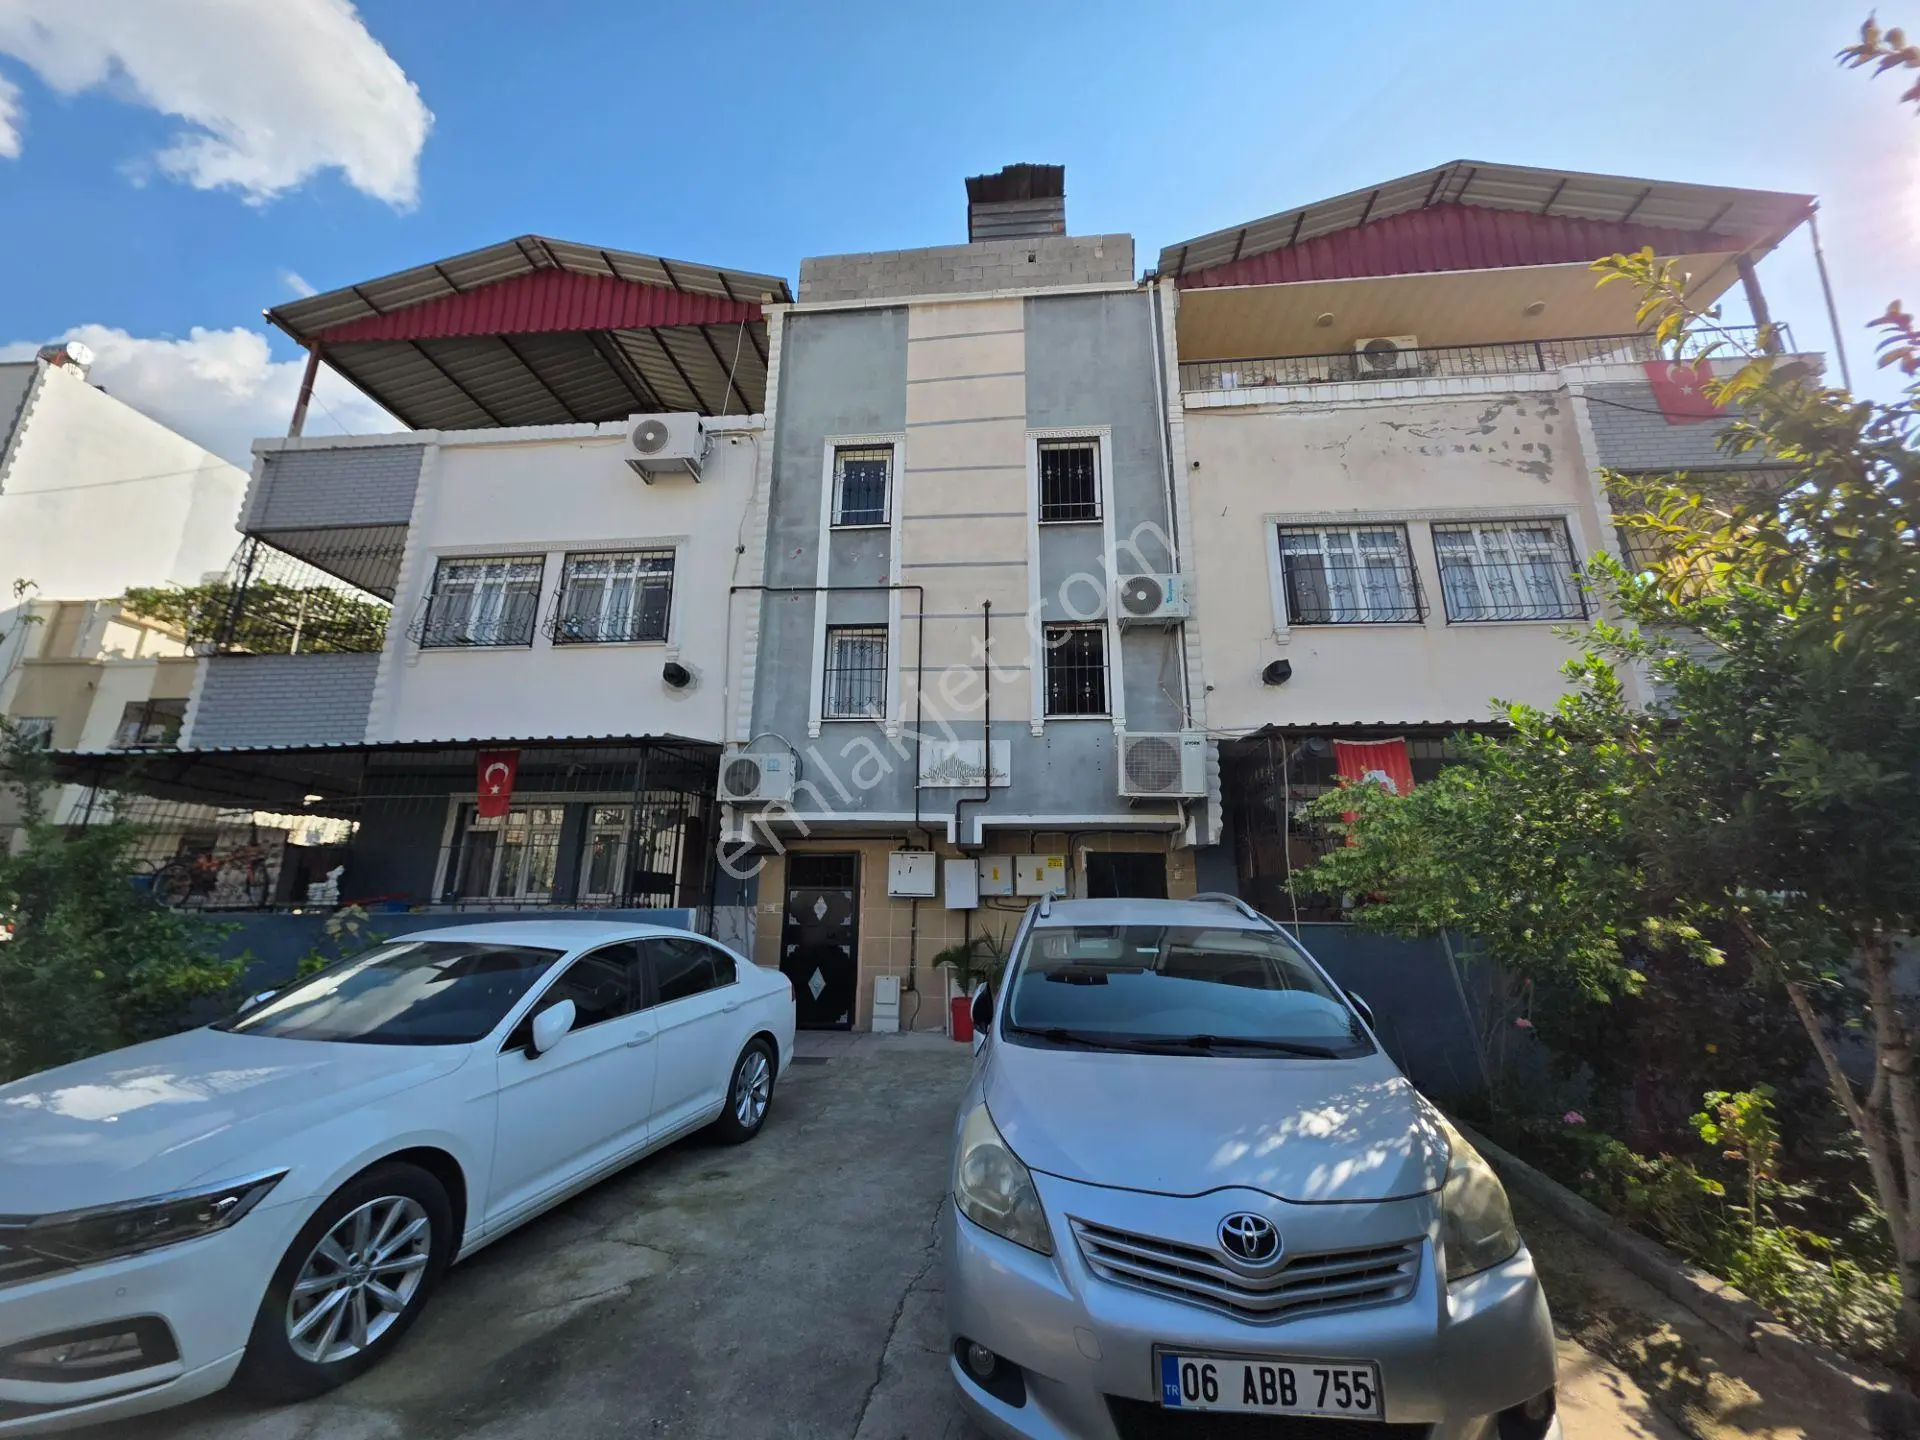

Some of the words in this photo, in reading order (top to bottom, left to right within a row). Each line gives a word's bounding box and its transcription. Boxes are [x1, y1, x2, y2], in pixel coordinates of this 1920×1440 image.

[1165, 1383, 1180, 1397] TR
[1182, 1362, 1218, 1403] 06
[1243, 1365, 1298, 1406] ABB
[1313, 1369, 1372, 1409] 755
